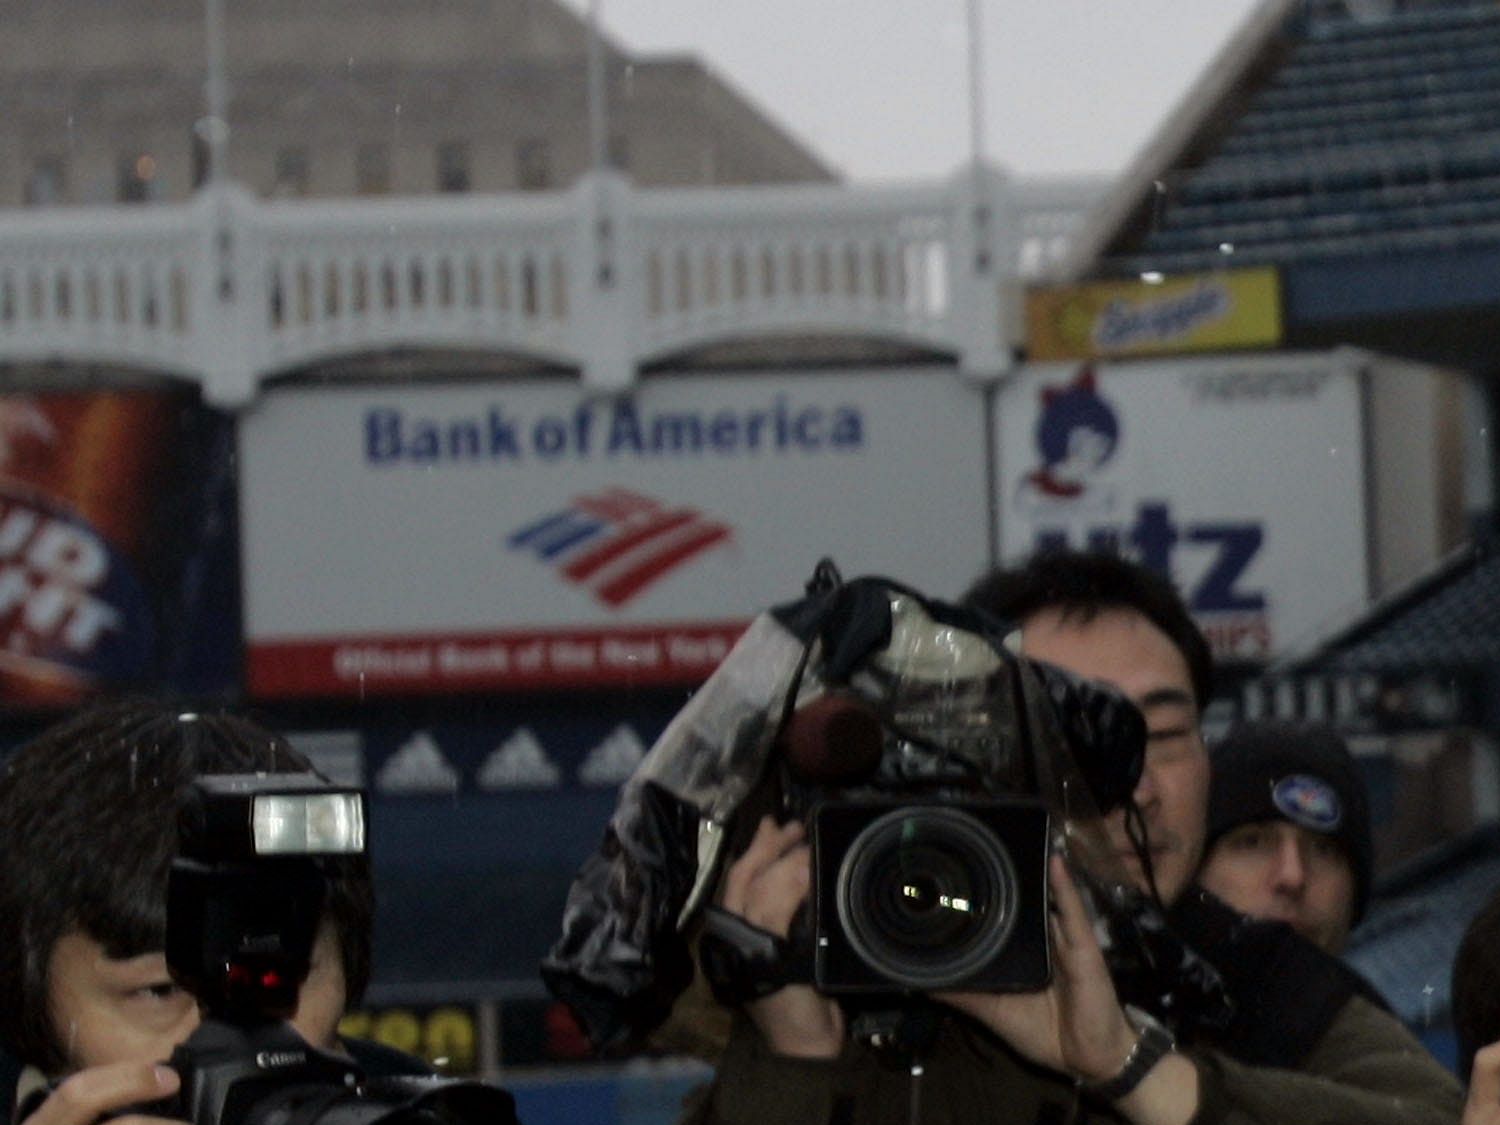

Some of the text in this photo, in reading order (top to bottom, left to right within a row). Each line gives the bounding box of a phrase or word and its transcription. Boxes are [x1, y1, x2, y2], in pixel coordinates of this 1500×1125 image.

[365, 394, 865, 464] Bank of America
[333, 644, 433, 679] Official
[436, 641, 511, 675] Bank
[550, 640, 597, 672] the
[600, 637, 661, 669] New
[256, 1051, 307, 1069] Canon
